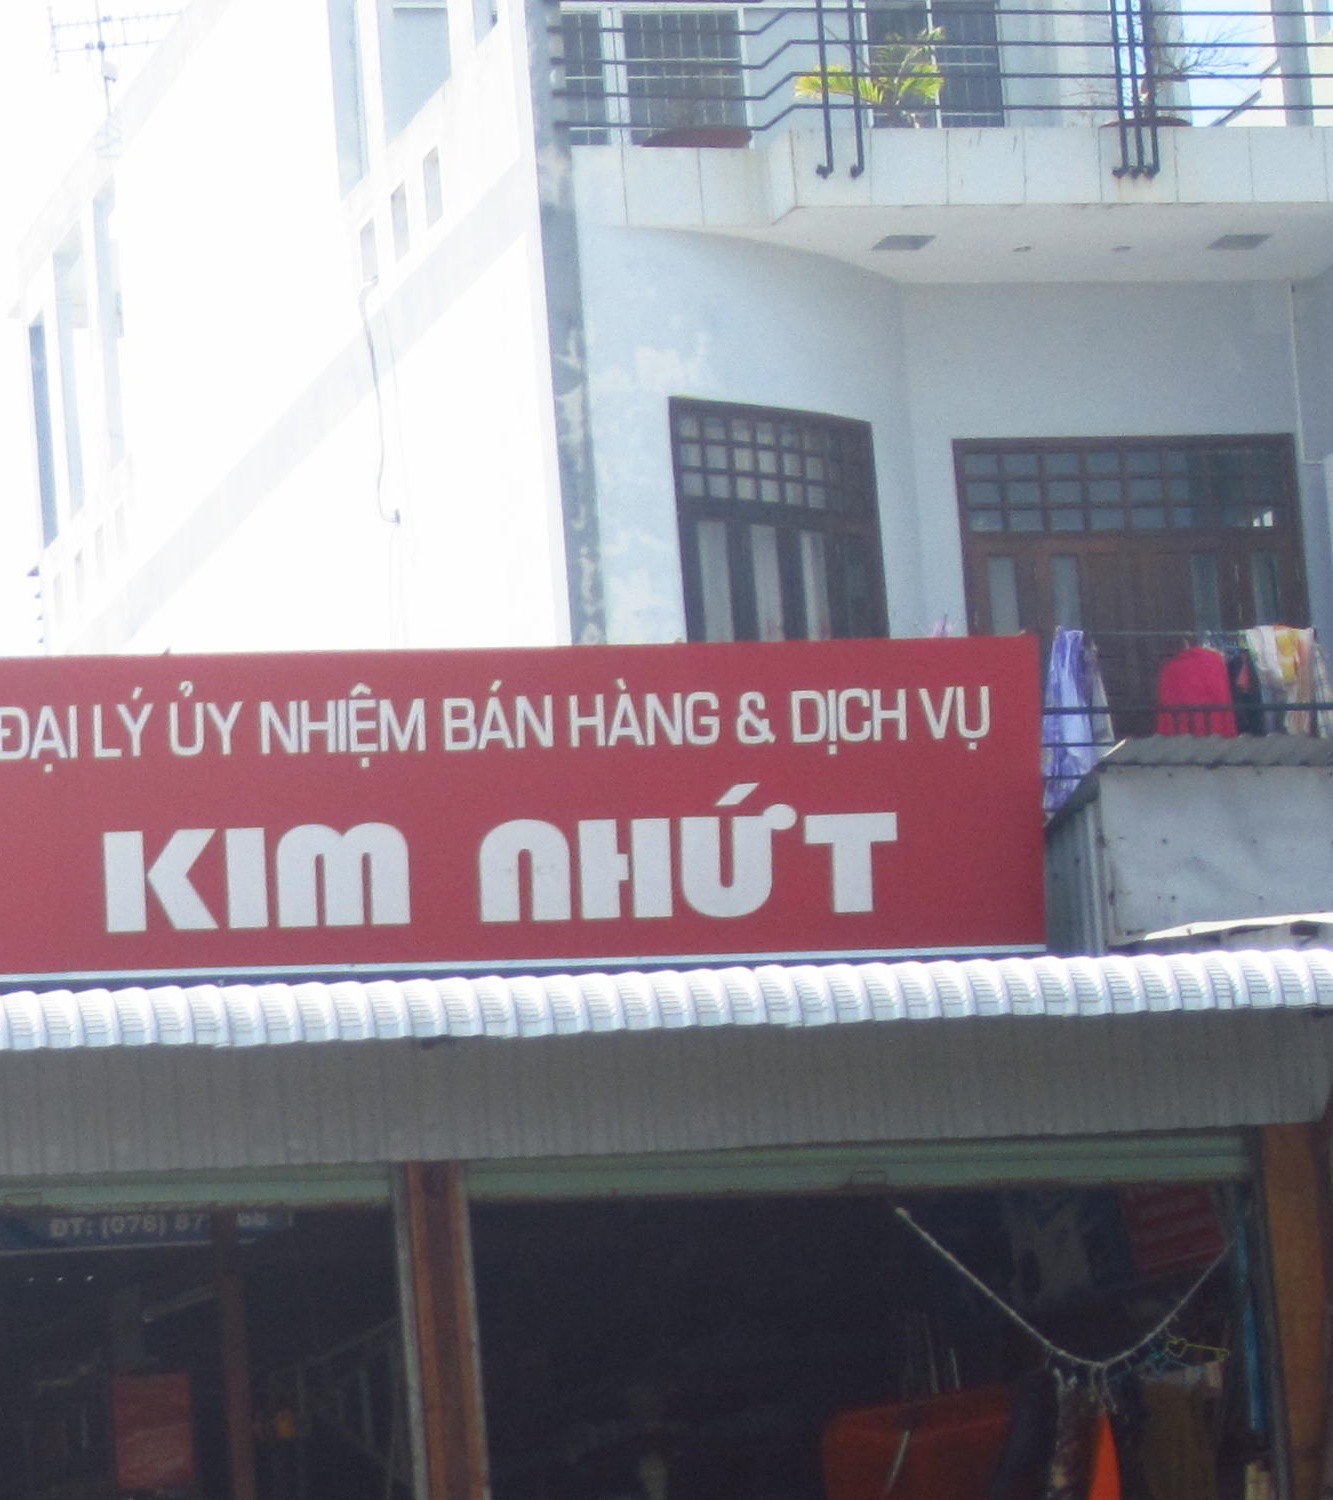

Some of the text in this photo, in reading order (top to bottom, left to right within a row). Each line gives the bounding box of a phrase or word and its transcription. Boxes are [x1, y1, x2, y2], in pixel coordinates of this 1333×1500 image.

[93, 687, 153, 759] LÝ
[169, 680, 243, 756] ỦY
[259, 682, 426, 768] NHIỆM
[442, 679, 555, 752] BÁN
[569, 678, 721, 749] HÀNG
[736, 692, 776, 743] &
[792, 687, 907, 755] DỊCH
[920, 685, 991, 750] VỤ
[102, 782, 898, 933] KIM NHỨT
